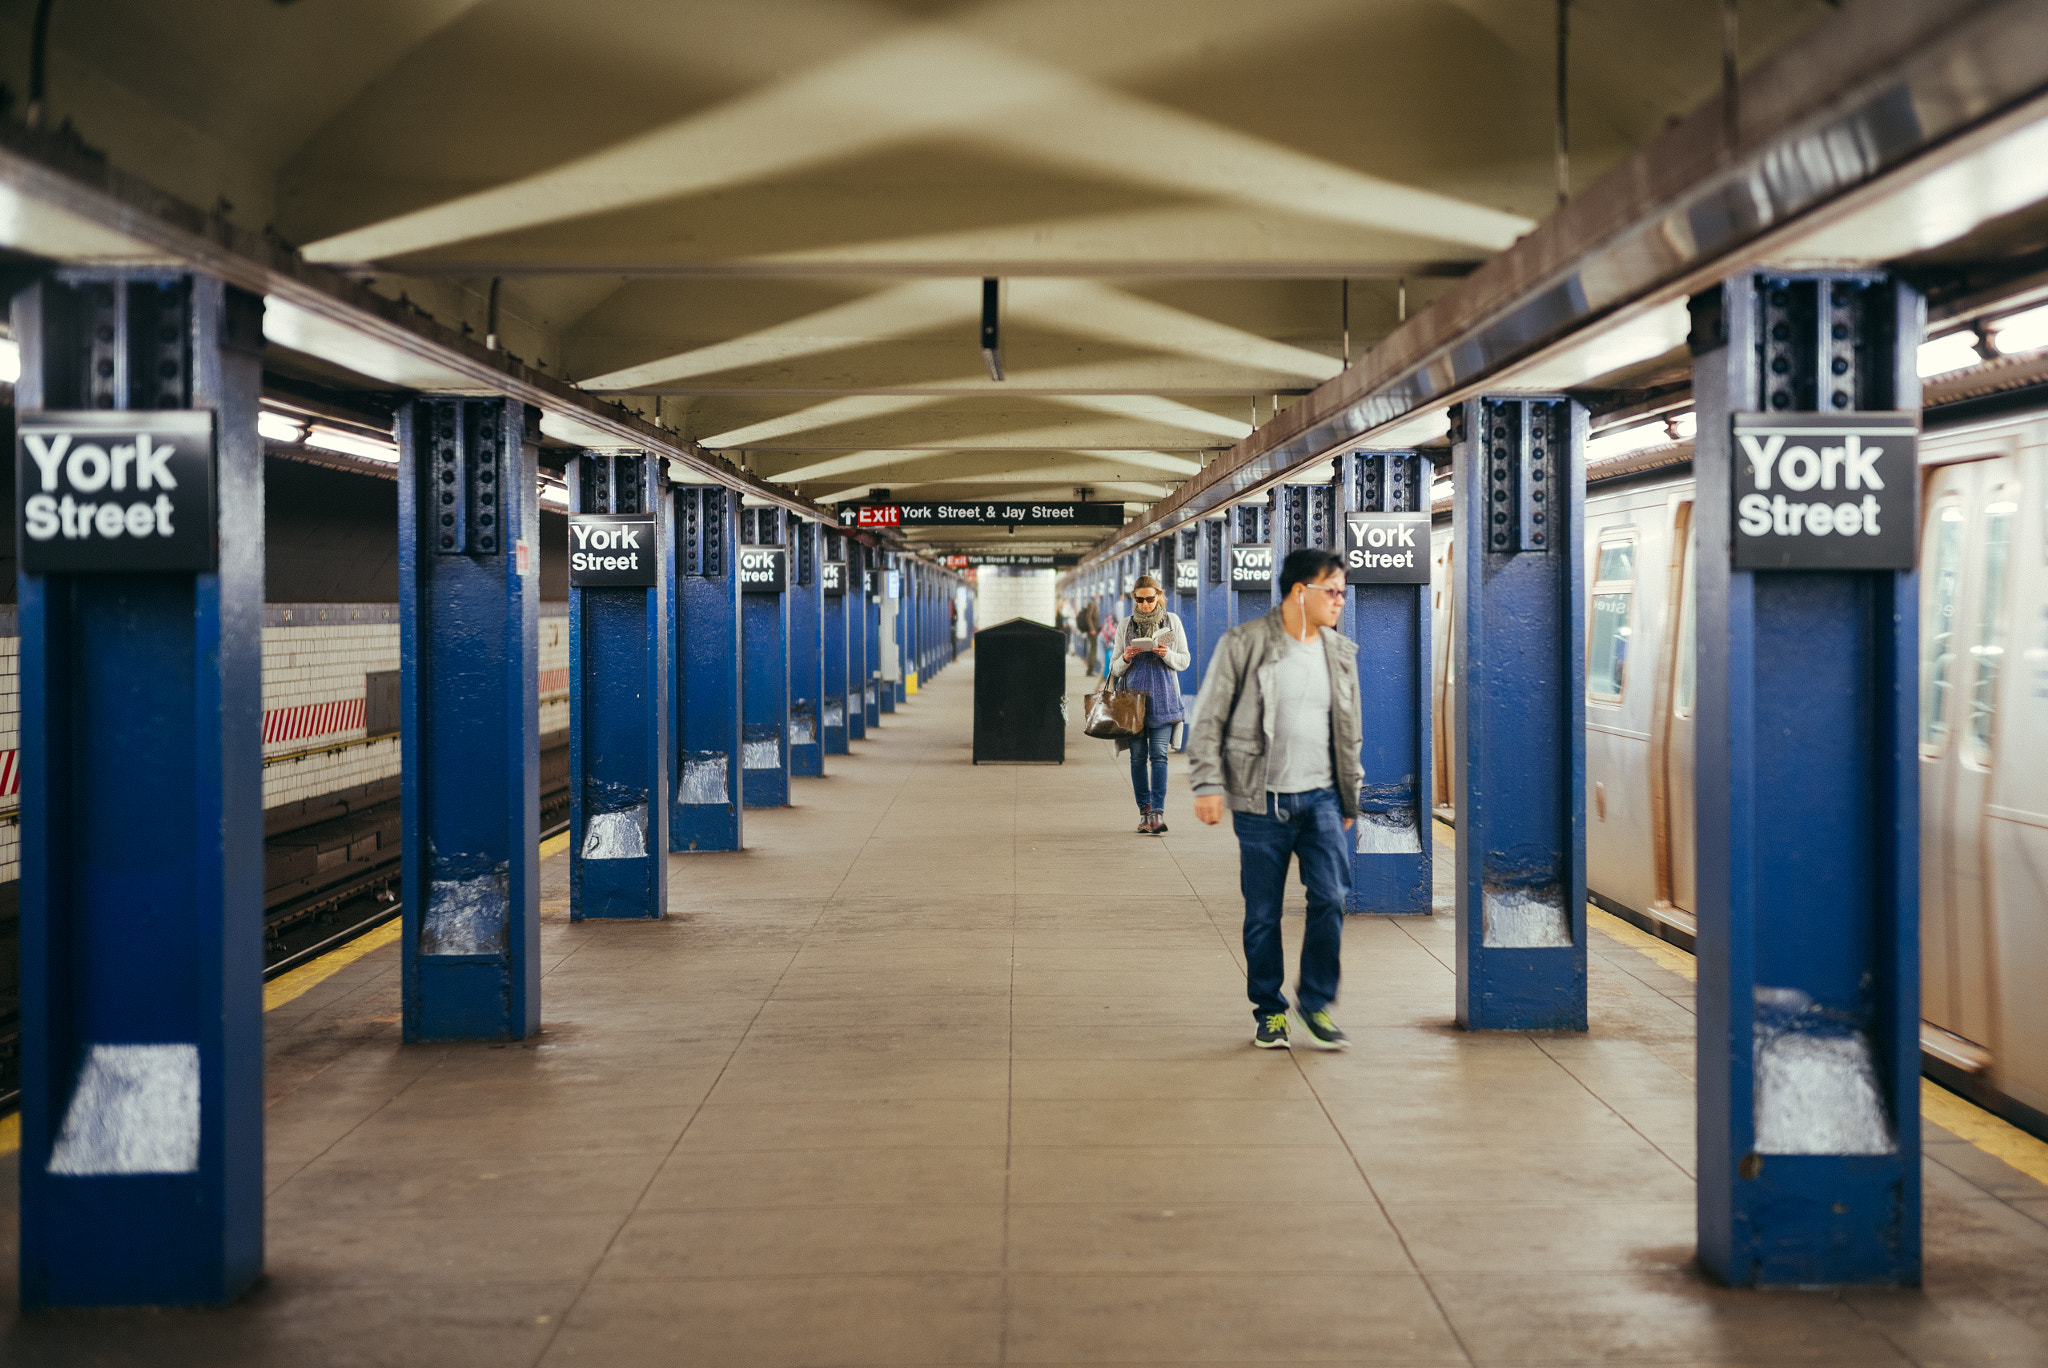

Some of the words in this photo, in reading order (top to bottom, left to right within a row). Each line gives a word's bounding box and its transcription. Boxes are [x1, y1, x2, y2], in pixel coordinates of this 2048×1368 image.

[23, 432, 178, 493] York
[1738, 433, 1886, 492] York
[24, 494, 175, 541] Street
[859, 506, 897, 523] Exit
[901, 506, 932, 519] York
[938, 505, 981, 519] Street
[985, 505, 996, 518] &
[1001, 506, 1026, 521] Jay
[1031, 505, 1075, 519] Street
[1737, 494, 1882, 537] Street
[571, 524, 640, 550] York
[1349, 522, 1416, 548] York
[571, 552, 639, 571] Street
[947, 556, 967, 566] Exit
[1349, 549, 1414, 569] Street
[741, 568, 774, 583] treet
[1233, 567, 1272, 581] Stree
